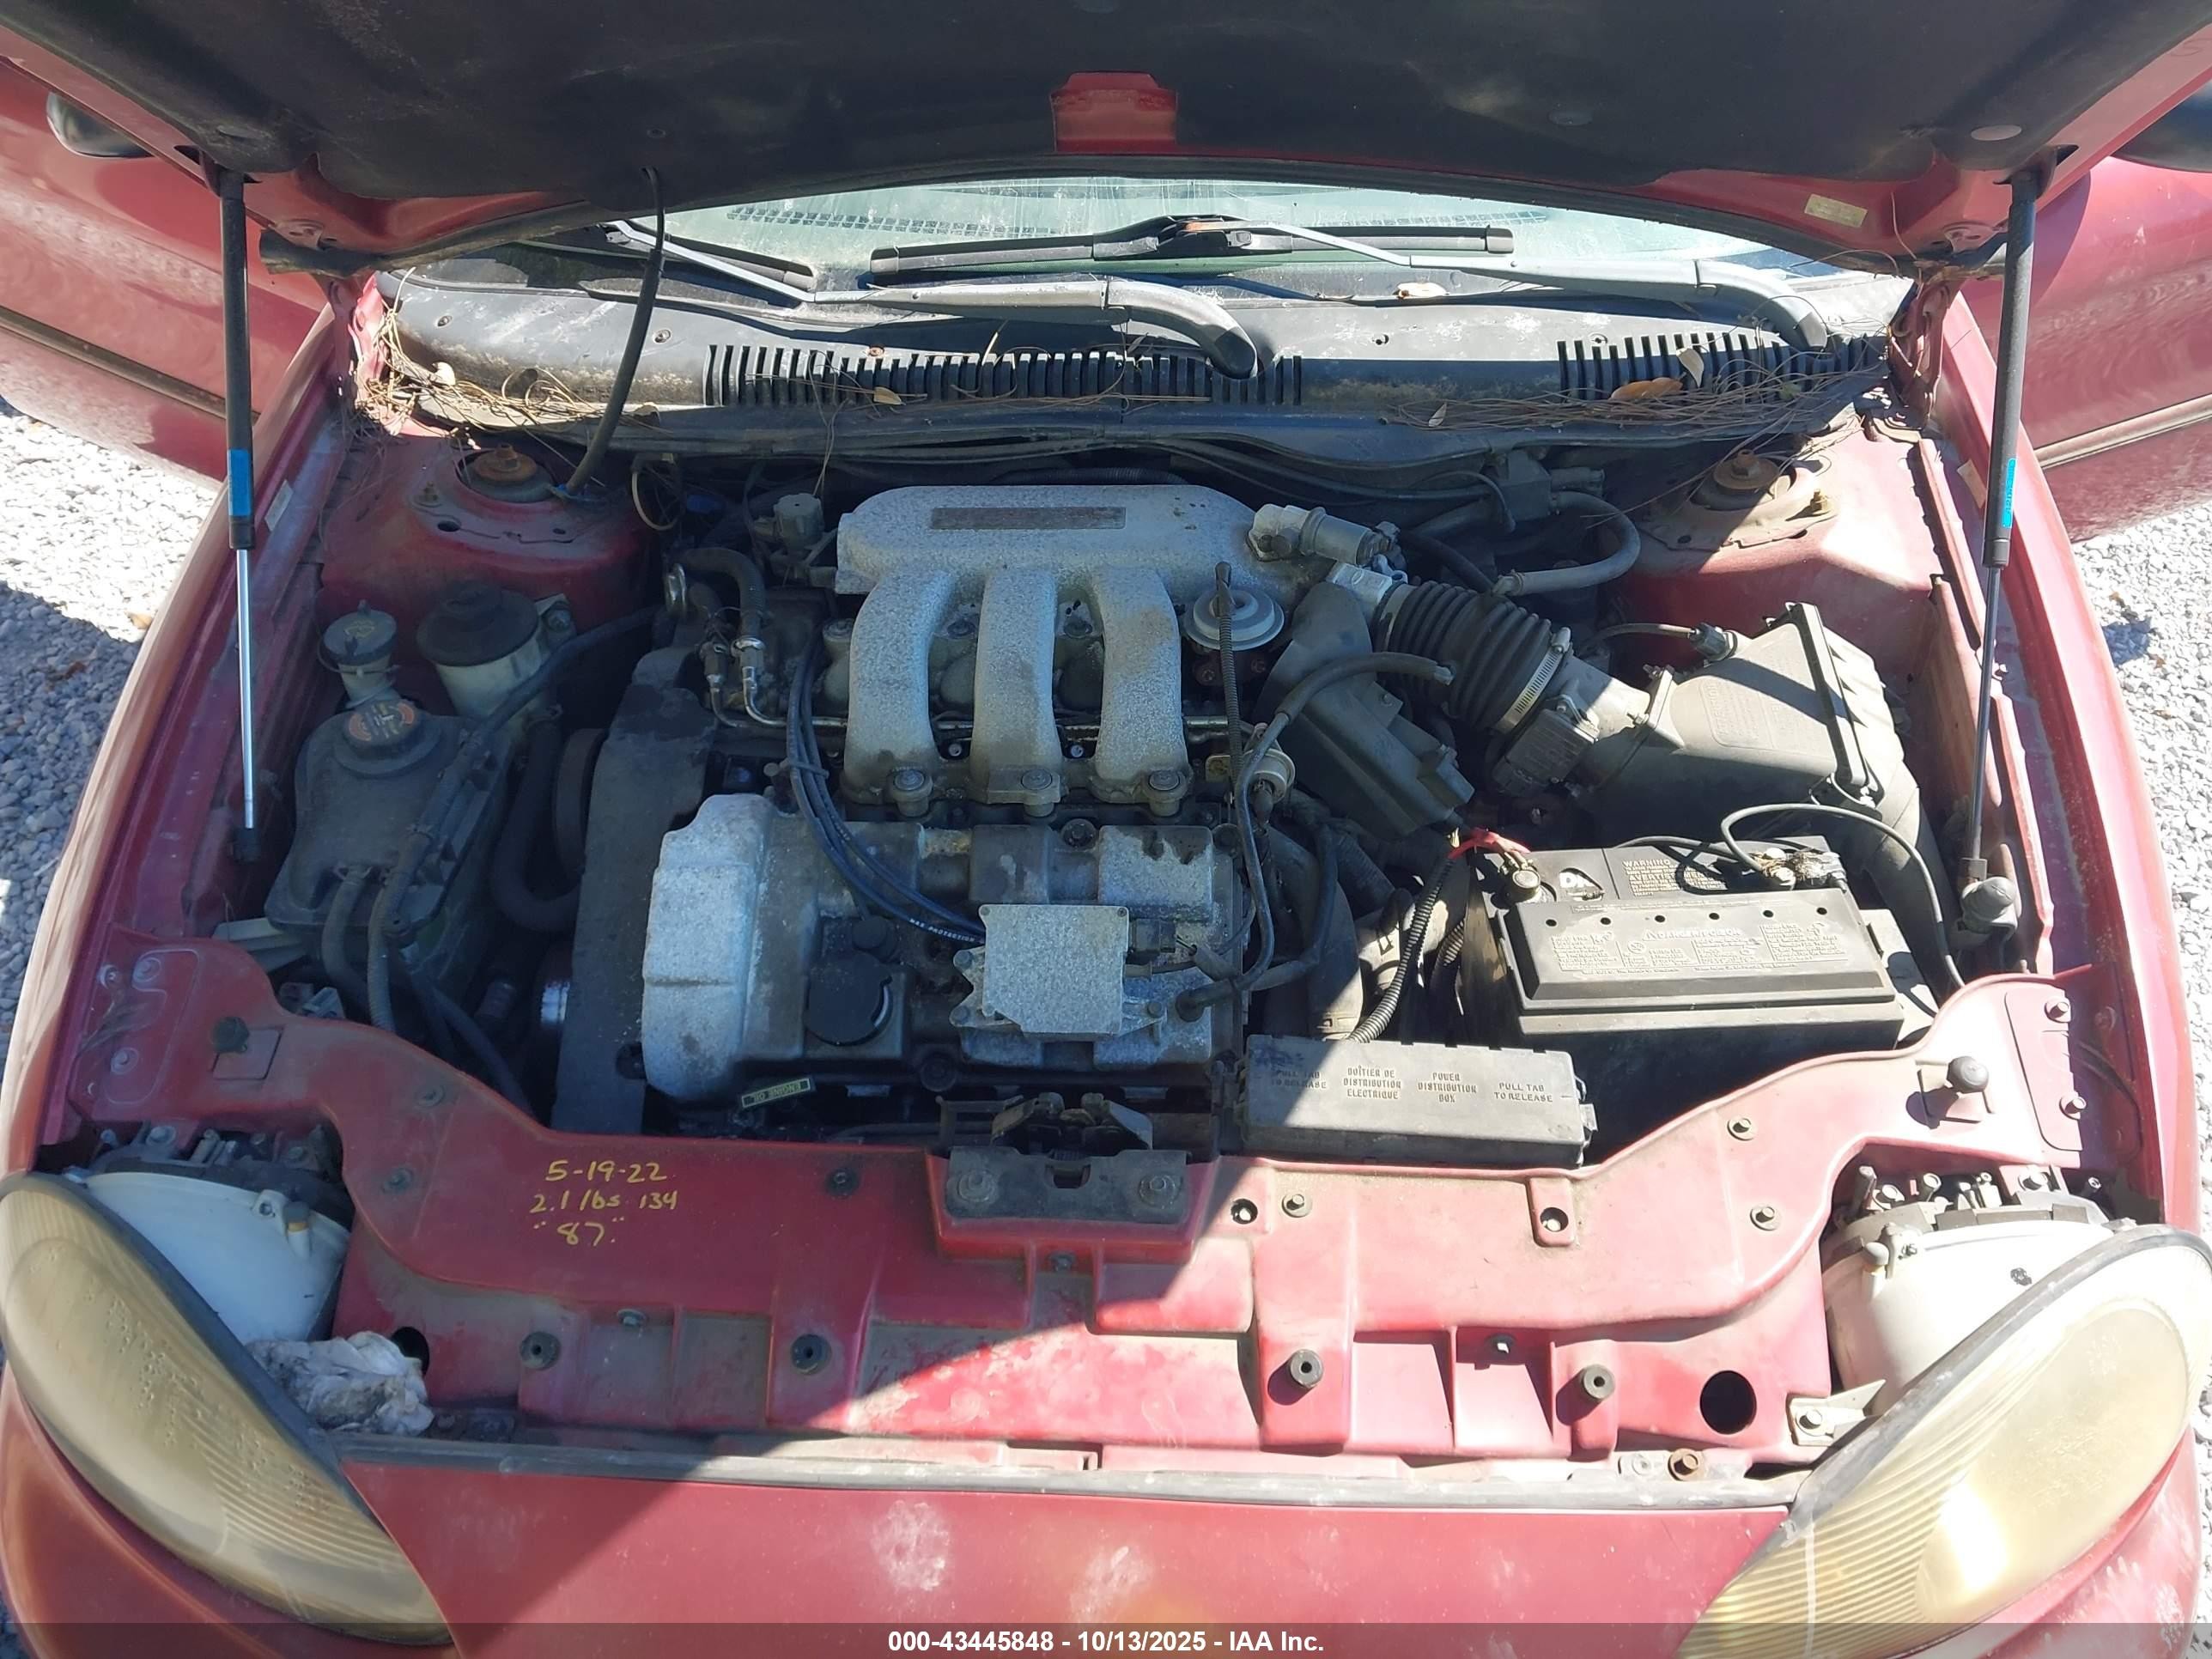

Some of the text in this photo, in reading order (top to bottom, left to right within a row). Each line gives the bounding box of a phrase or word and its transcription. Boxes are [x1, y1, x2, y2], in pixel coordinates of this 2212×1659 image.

[1622, 859, 1671, 868] WARNING
[1384, 1070, 1395, 1079] DE
[1432, 1073, 1461, 1082] POWER
[1343, 1078, 1401, 1089] DISTRIBUTION
[1418, 1082, 1478, 1093] DISTRIBUTION
[1499, 1082, 1545, 1092] PULL TAB
[1438, 1093, 1456, 1103] BOX
[1494, 1091, 1553, 1103] TO RELEASE
[545, 1160, 667, 1182] 5-19-22
[529, 1189, 570, 1213] 2.1
[639, 1190, 678, 1211] 134
